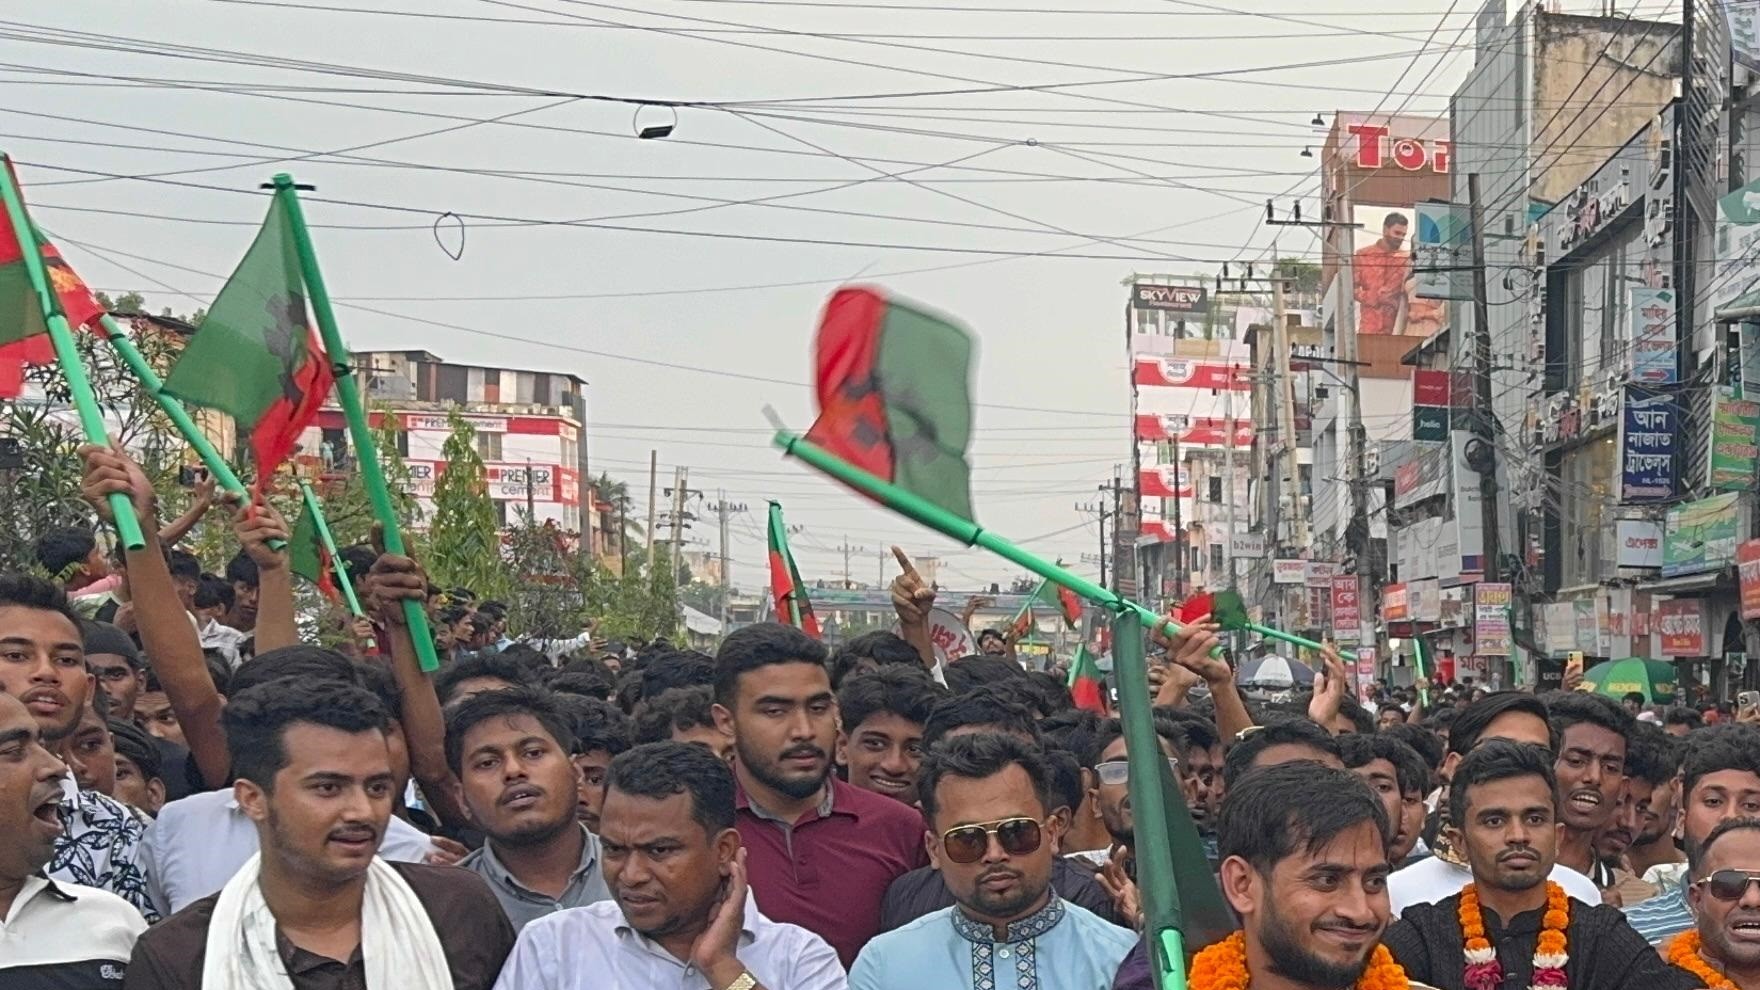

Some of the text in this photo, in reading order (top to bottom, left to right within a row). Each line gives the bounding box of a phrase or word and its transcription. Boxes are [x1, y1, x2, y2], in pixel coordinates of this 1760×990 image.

[1140, 288, 1201, 303] SKYVIEW
[1627, 432, 1672, 448] নাজাত
[500, 469, 550, 483] PREMIER
[501, 484, 551, 496] cement
